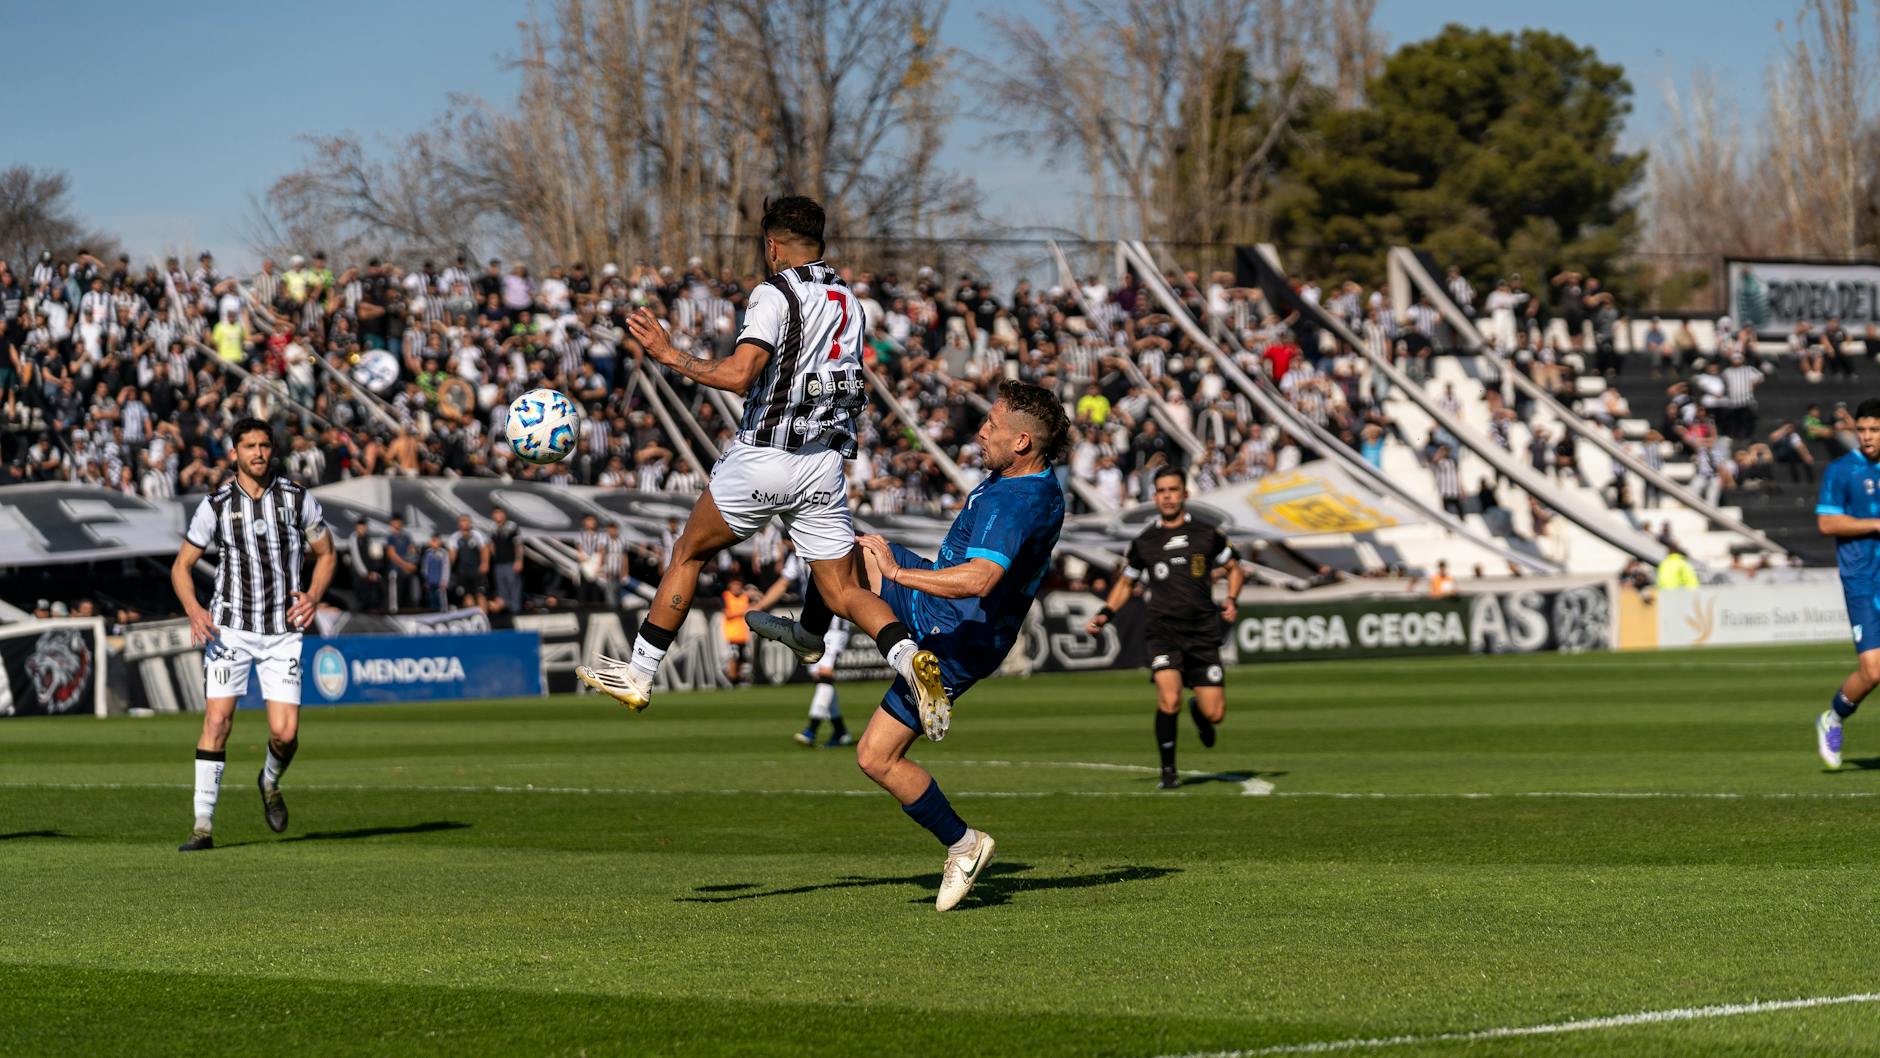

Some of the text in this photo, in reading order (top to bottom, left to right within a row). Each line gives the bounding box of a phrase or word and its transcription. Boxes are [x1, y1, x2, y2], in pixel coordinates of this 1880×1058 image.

[826, 291, 847, 359] 7
[1238, 610, 1466, 652] CEOSA CEOSA
[351, 656, 466, 684] MENDOZA
